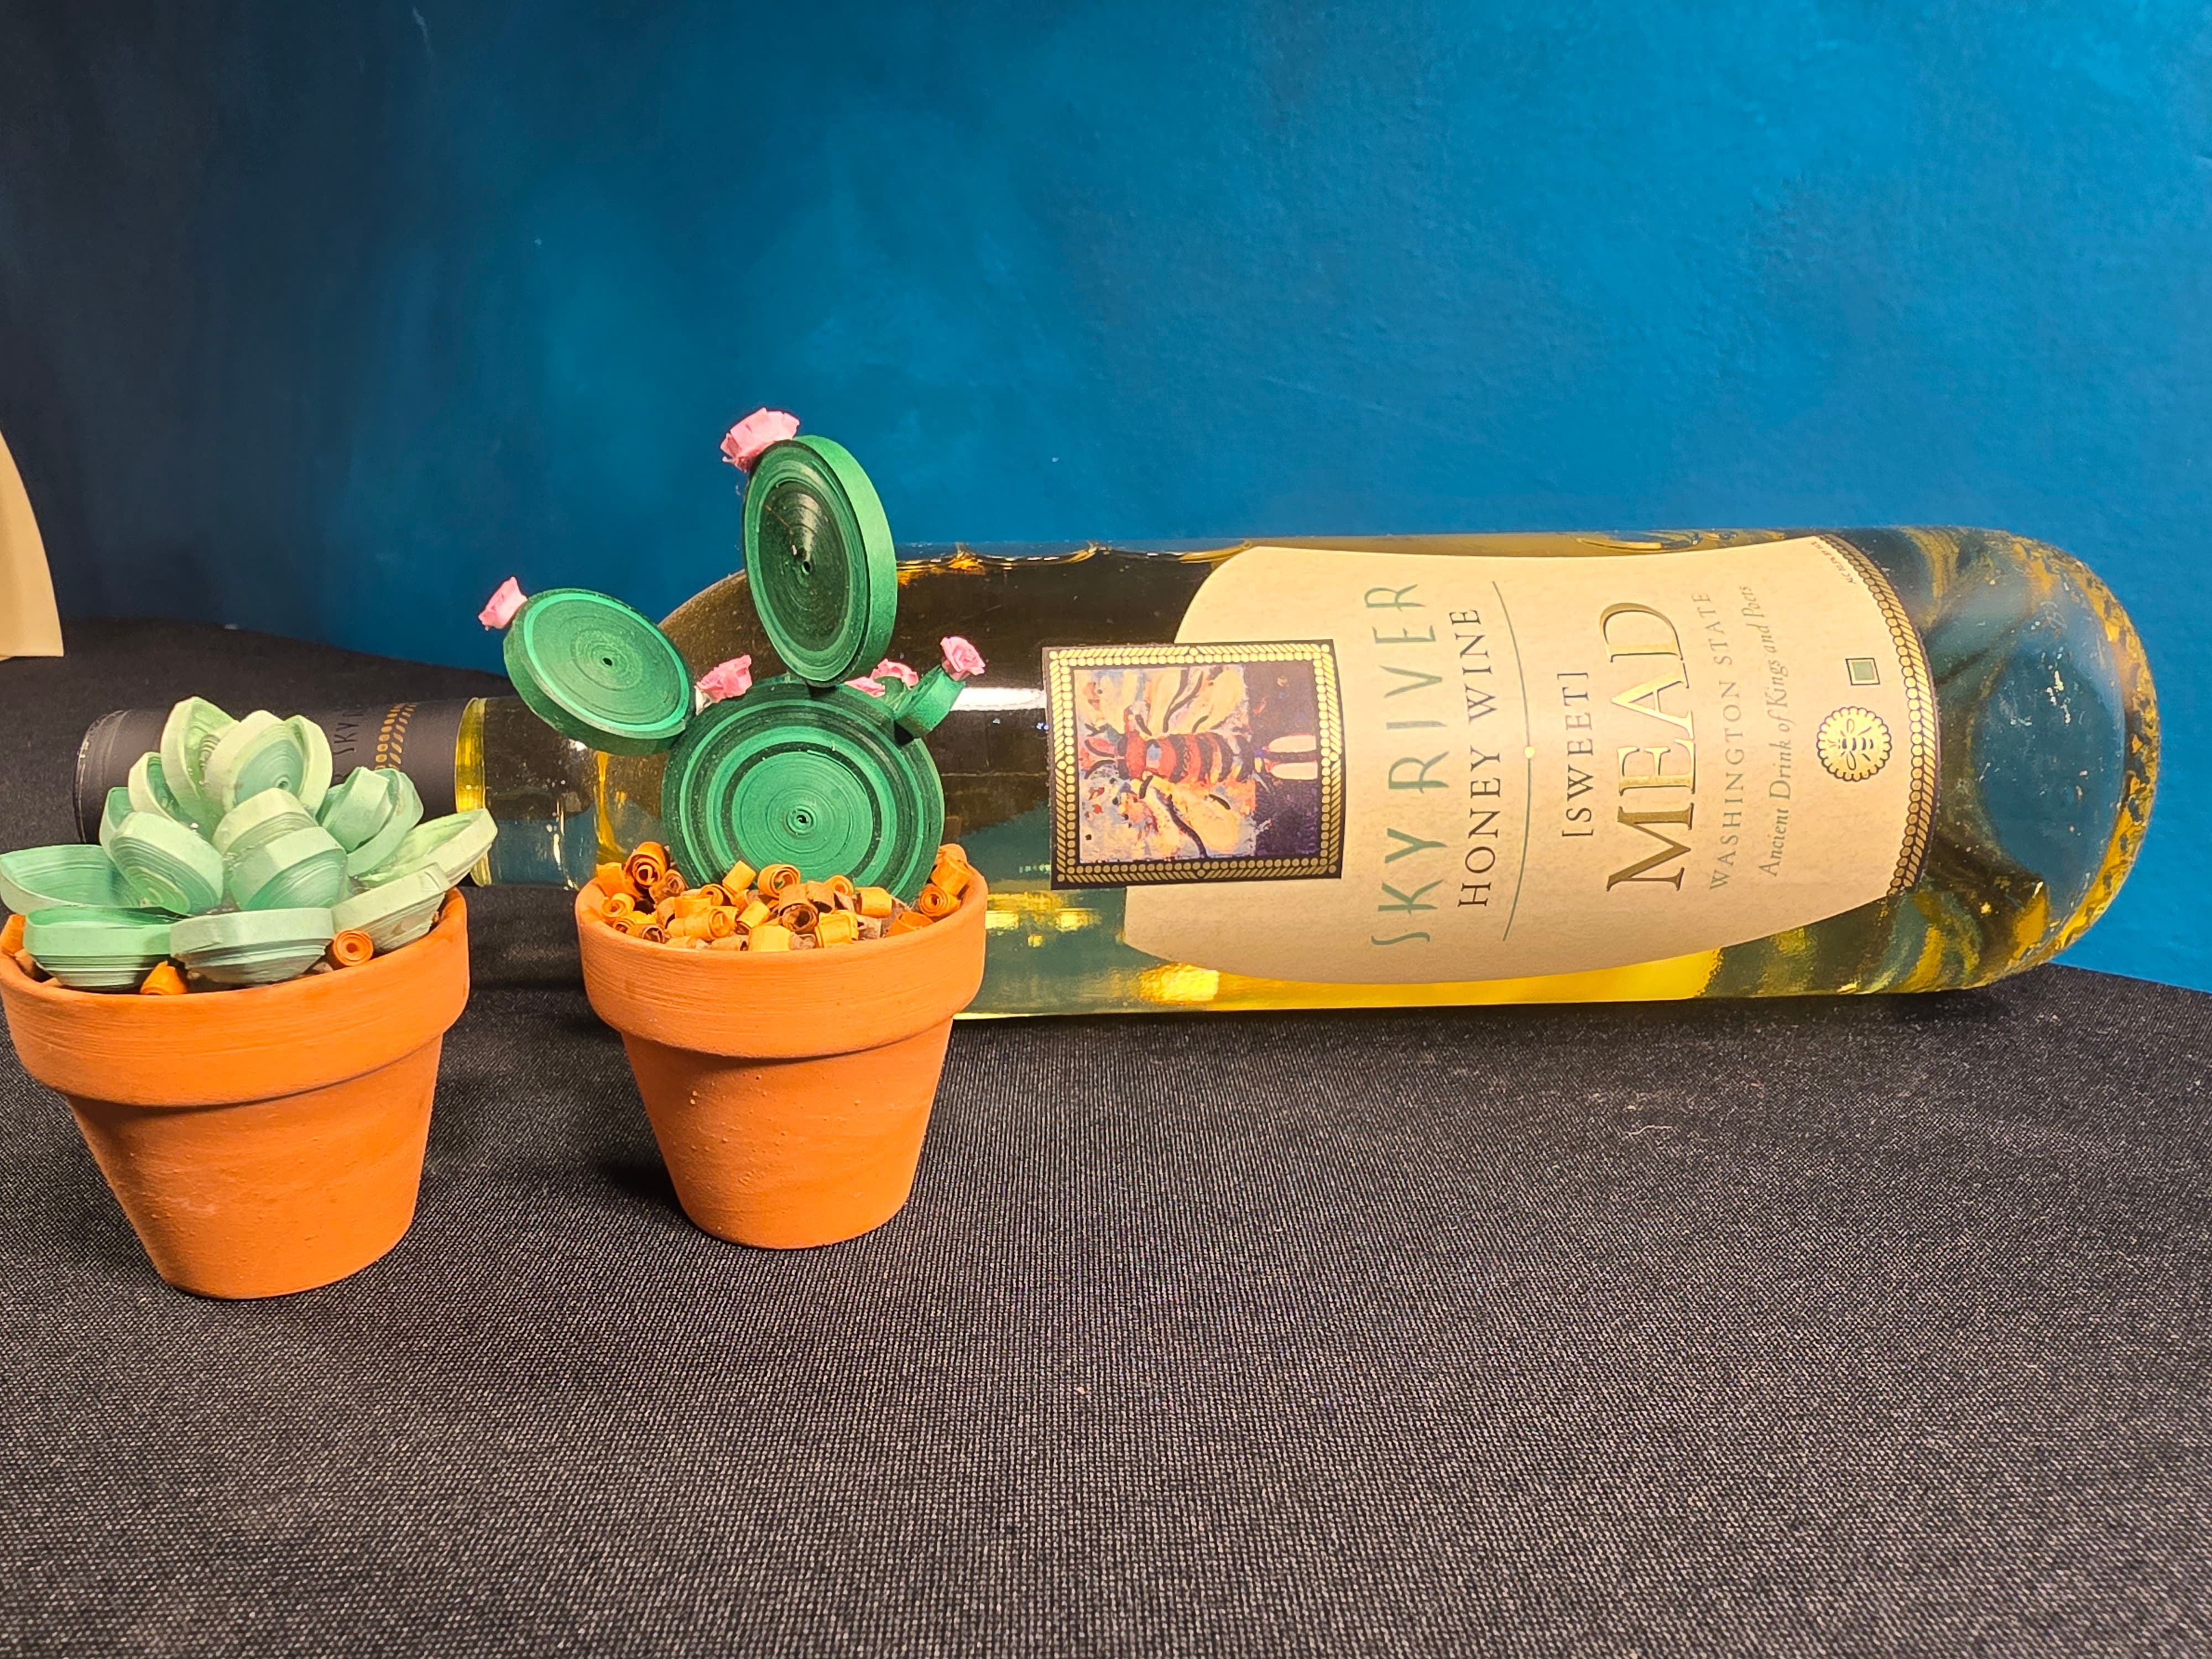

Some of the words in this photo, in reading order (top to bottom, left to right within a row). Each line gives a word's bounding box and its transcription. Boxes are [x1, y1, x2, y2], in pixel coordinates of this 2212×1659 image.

[1691, 592, 1733, 666] STATE
[1739, 585, 1765, 618] Poets
[1745, 623, 1777, 654] and
[1363, 583, 1449, 794] RIVER
[1448, 608, 1498, 725] WINE
[1764, 659, 1789, 708] Kings
[333, 722, 359, 755] SKY
[1557, 672, 1594, 837] [SWEET]
[1599, 602, 1696, 892] MEAD
[1767, 708, 1797, 733] of
[1708, 680, 1745, 890] WASHINGTON
[1768, 739, 1792, 800] Drink
[1457, 744, 1501, 907] HONEY
[1758, 808, 1789, 878] Ancient
[1370, 827, 1448, 946] SKY
